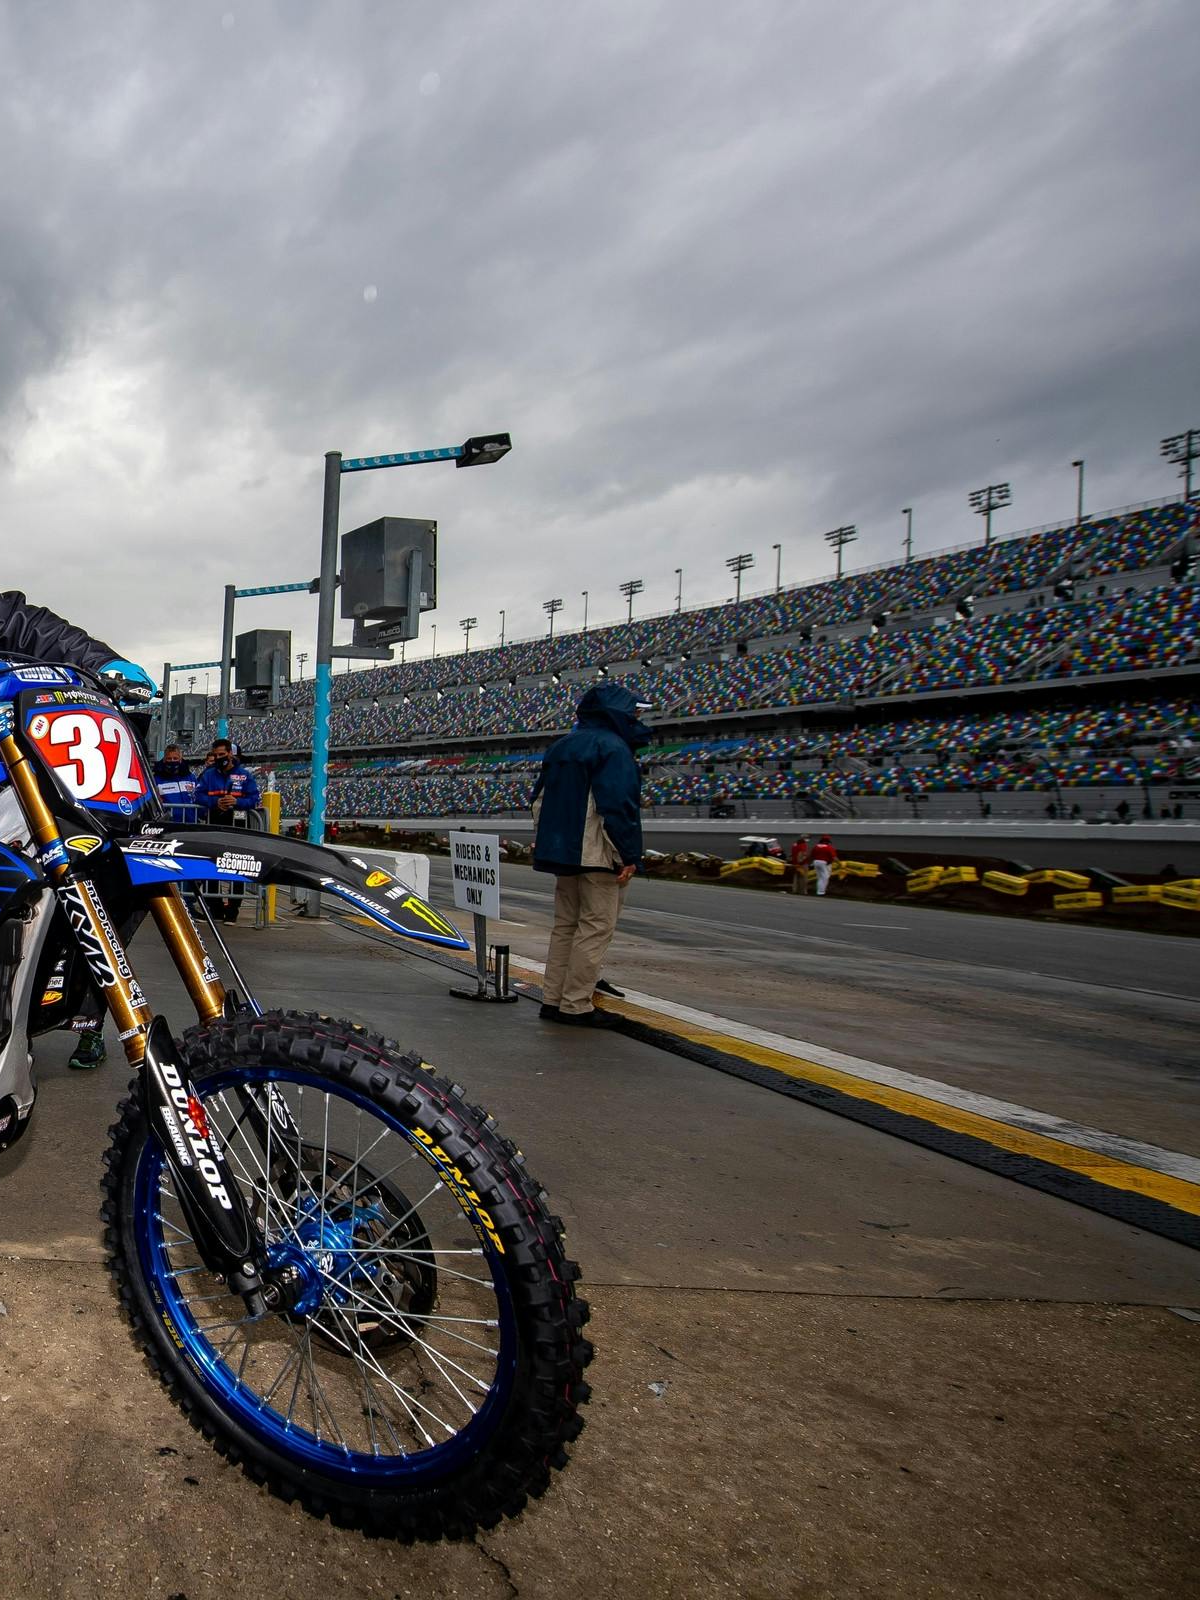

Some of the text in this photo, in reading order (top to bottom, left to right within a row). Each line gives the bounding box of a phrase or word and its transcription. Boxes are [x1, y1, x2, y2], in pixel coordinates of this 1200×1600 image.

[62, 690, 99, 703] MONSTER
[50, 714, 142, 800] 32
[216, 857, 262, 872] ESCONDIDO
[231, 853, 255, 861] TOYOTA
[455, 843, 491, 863] RIDERS &
[454, 863, 496, 886] MECHANICS
[334, 884, 391, 917] SPECIALIZED
[466, 887, 483, 907] ONLY
[158, 1062, 233, 1210] DUNLOP
[161, 1107, 193, 1167] BRAKING
[410, 1126, 506, 1255] DUNLOP
[438, 1170, 473, 1216] EXCEL
